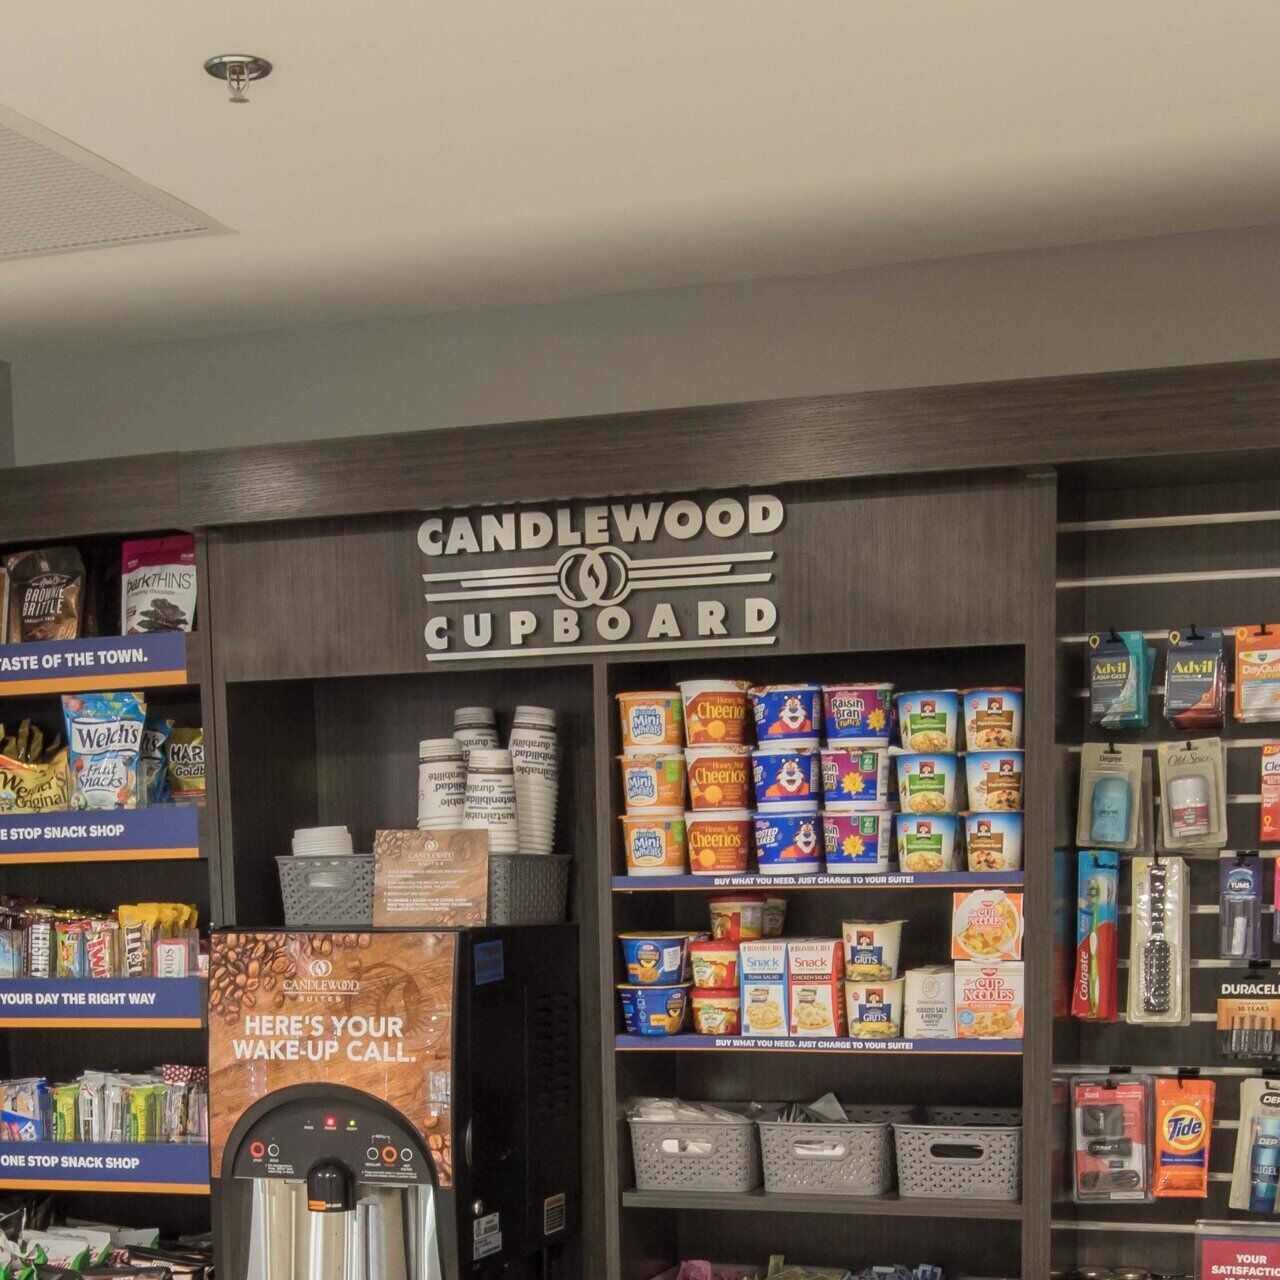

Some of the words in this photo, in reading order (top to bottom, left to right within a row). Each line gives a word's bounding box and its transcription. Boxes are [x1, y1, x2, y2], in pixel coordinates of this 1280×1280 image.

[417, 494, 784, 556] CANDLEWOOD
[424, 598, 776, 650] CUPBOARD
[42, 654, 61, 668] OF
[65, 652, 94, 667] THE
[98, 649, 148, 664] TOWN.
[1093, 662, 1127, 674] Advil
[1172, 660, 1214, 673] Advil
[1242, 663, 1280, 676] DayQuil
[831, 698, 864, 710] Raisin
[633, 715, 660, 726] Mini
[836, 709, 860, 720] Bran
[76, 723, 139, 747] Welch's
[1099, 755, 1122, 763] Degree
[695, 768, 745, 784] Cheerios
[628, 777, 652, 788] Mini
[10, 828, 42, 840] STOP
[44, 826, 87, 839] SNACK
[90, 824, 124, 837] SHOP
[634, 838, 660, 849] Mini
[691, 833, 740, 848] Cheerios
[747, 957, 779, 967] Snack
[795, 958, 827, 968] Snack
[1079, 950, 1090, 1001] Colgate
[283, 980, 359, 991] CANDLEWOOD
[976, 978, 1004, 990] CUP
[0, 993, 33, 1005] YOUR
[36, 993, 59, 1005] DAY
[62, 993, 86, 1005] THE
[88, 993, 125, 1005] RIGHT
[128, 993, 156, 1005] WAY
[299, 995, 341, 1003] SUITES
[963, 989, 1014, 1001] NOODLES
[245, 1016, 323, 1038] HERE'S
[331, 1016, 403, 1038] YOUR
[233, 1039, 340, 1061] WAKE-UP
[346, 1040, 417, 1063] CALL.
[818, 1041, 851, 1049] CHARGE
[1168, 1117, 1201, 1141] Tide
[1, 1155, 25, 1167] ONE
[28, 1156, 59, 1168] STOP
[61, 1156, 103, 1168] SNACK
[106, 1158, 140, 1169] SHOP
[1236, 1253, 1267, 1264] YOUR
